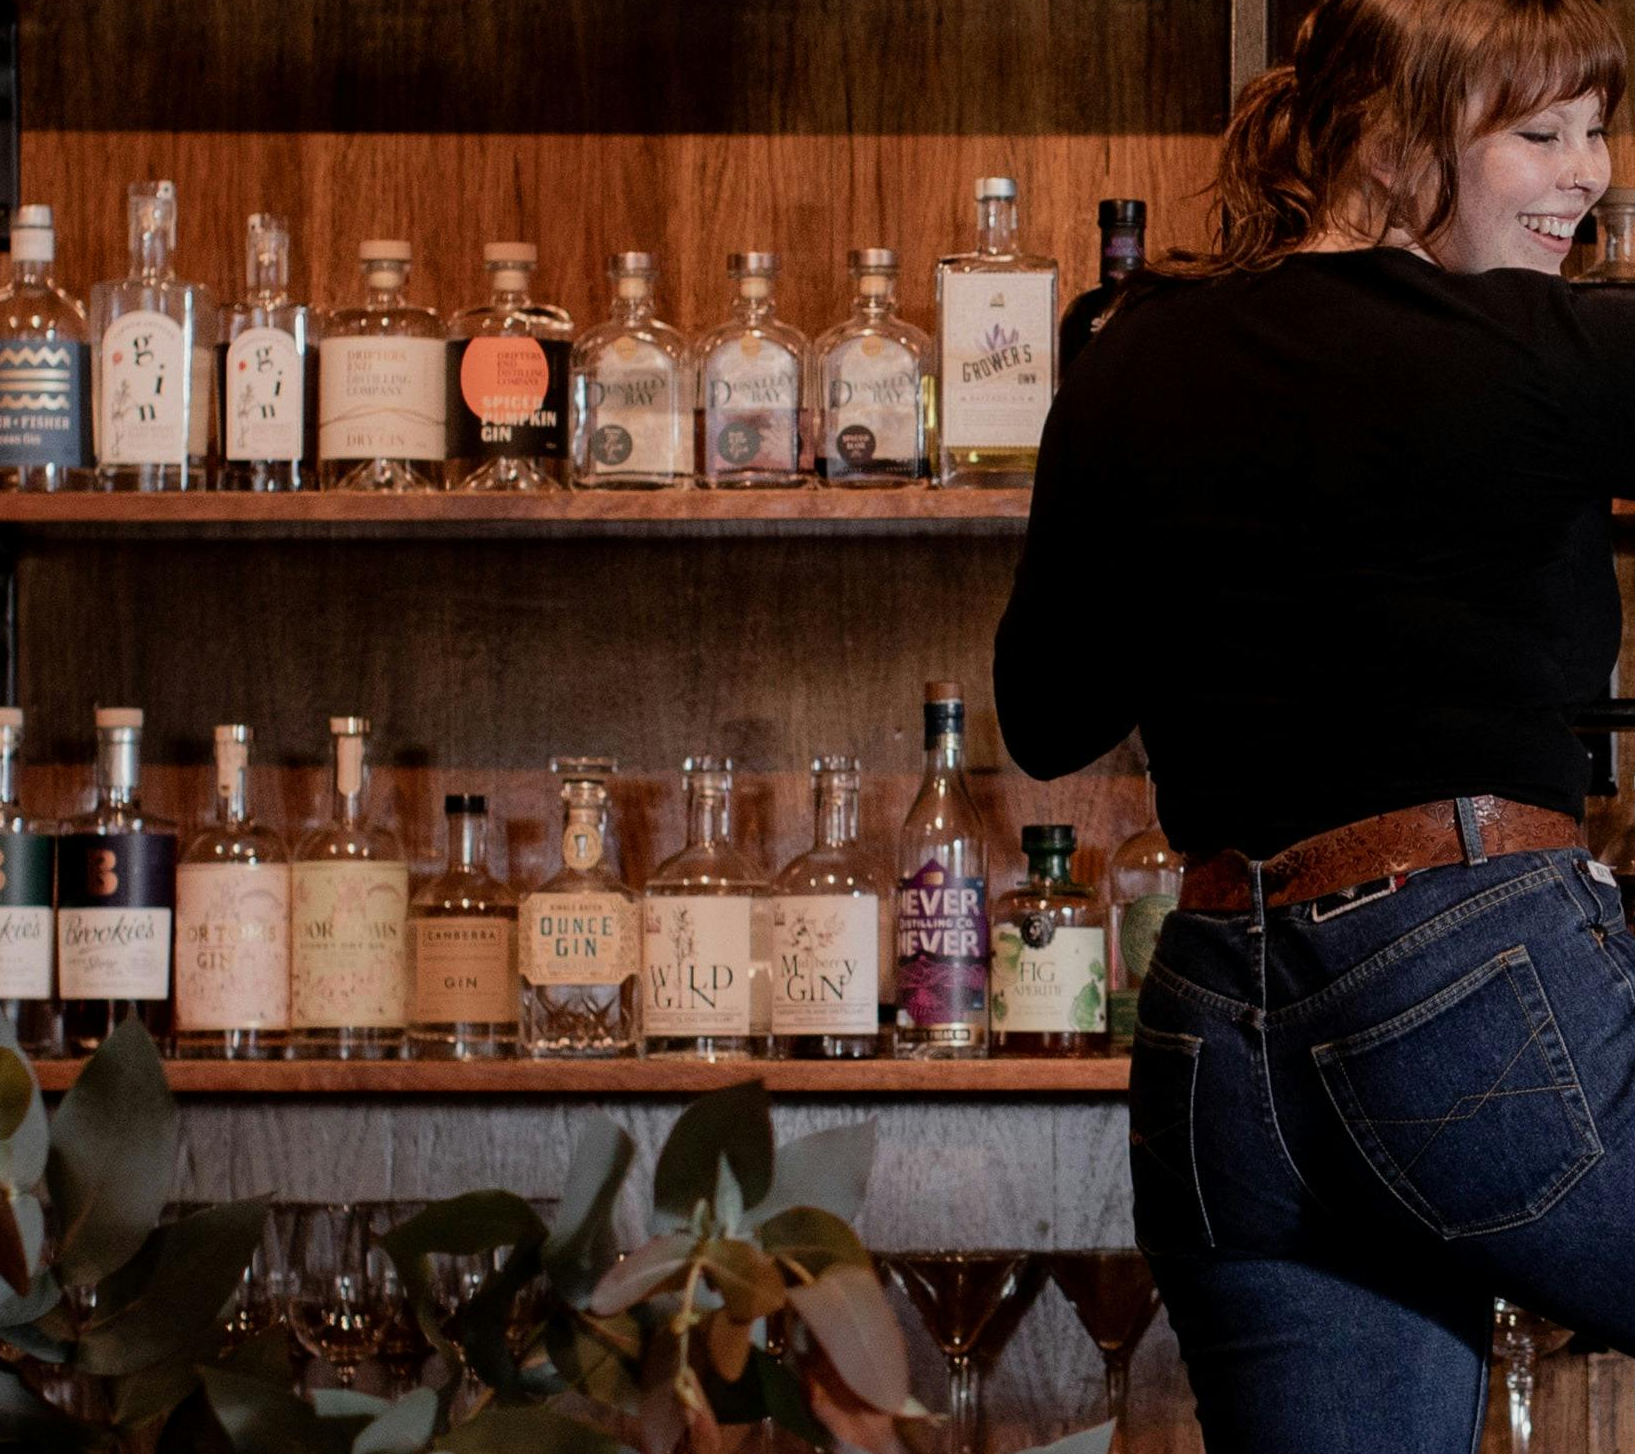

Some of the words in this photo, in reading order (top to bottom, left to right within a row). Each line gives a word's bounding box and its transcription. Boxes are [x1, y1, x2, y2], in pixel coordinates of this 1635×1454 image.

[481, 411, 557, 426] PUMPKIN
[481, 426, 513, 442] GIN
[540, 917, 614, 937] OUNCE
[555, 938, 597, 958] GIN
[445, 976, 479, 989] GIN
